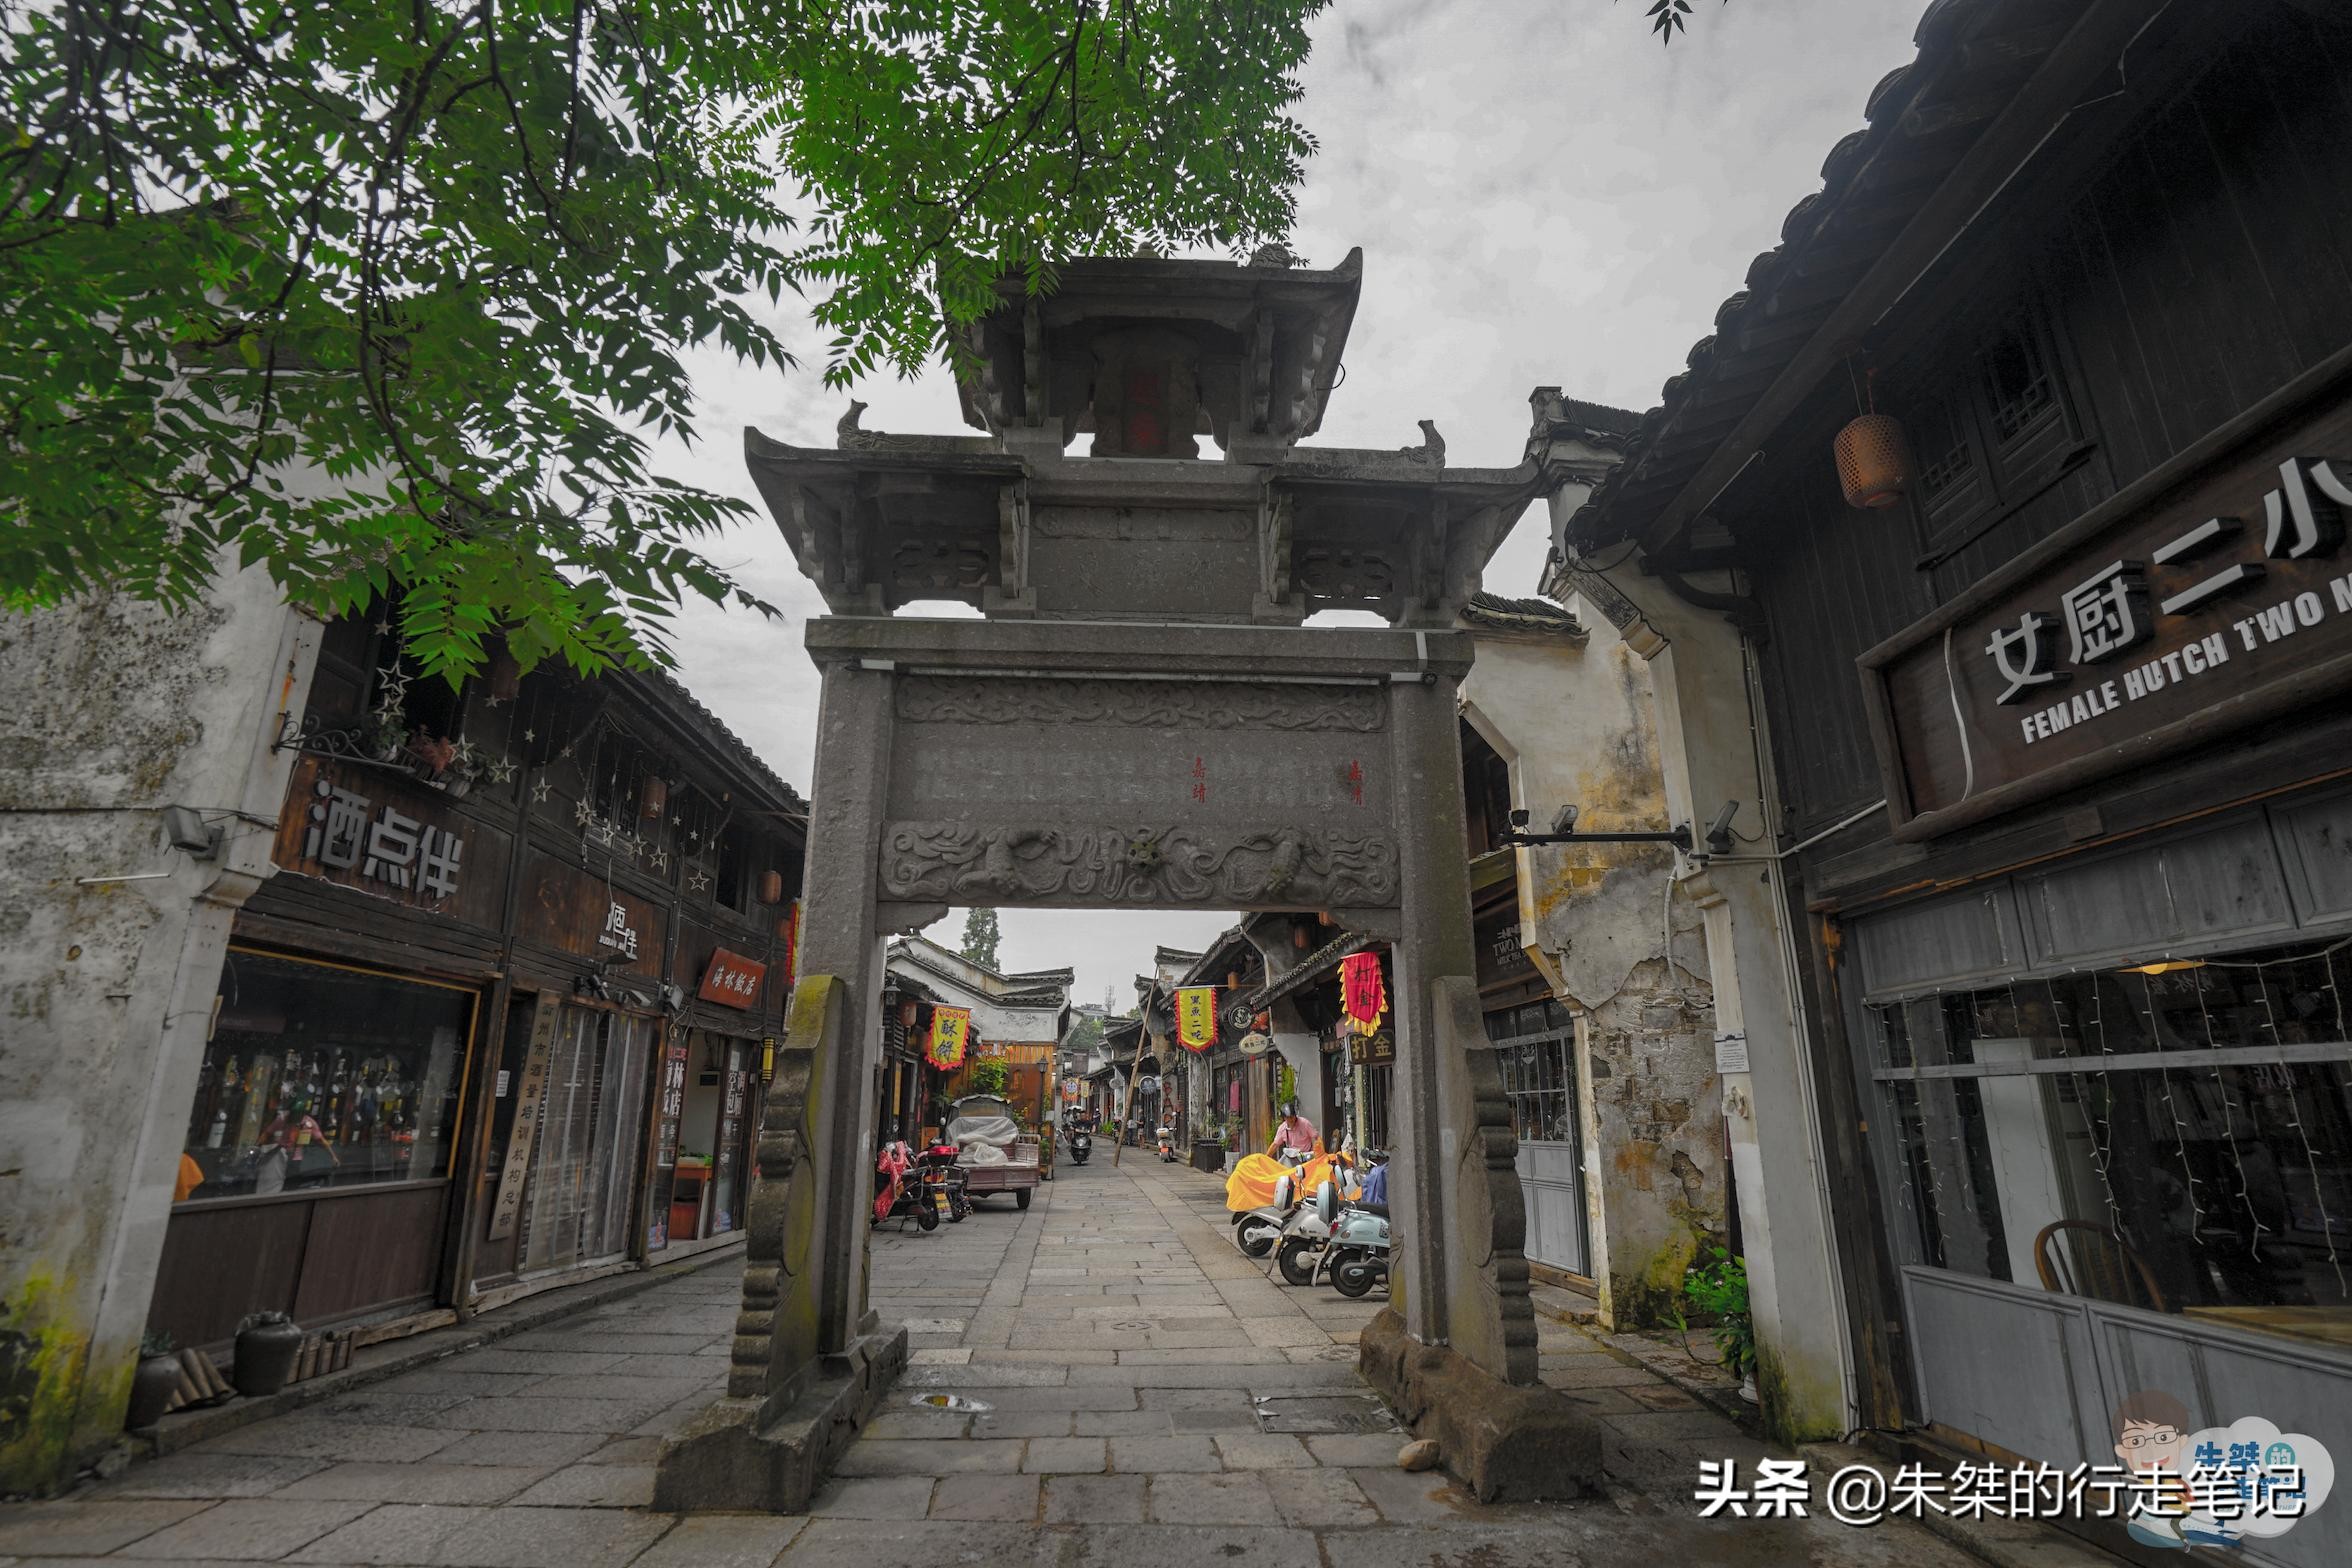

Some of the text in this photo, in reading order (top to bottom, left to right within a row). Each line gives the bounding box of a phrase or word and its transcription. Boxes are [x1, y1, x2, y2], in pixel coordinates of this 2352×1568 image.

[1984, 456, 2352, 705] 女厨二小
[2020, 679, 2121, 744] FEMALE
[2123, 631, 2230, 701] HUTCH
[2233, 590, 2324, 652] TWO
[302, 779, 464, 899] 酒点伴
[1492, 938, 1514, 957] TWO
[1354, 968, 1374, 1007] 打金
[1351, 1034, 1392, 1060] 打金
